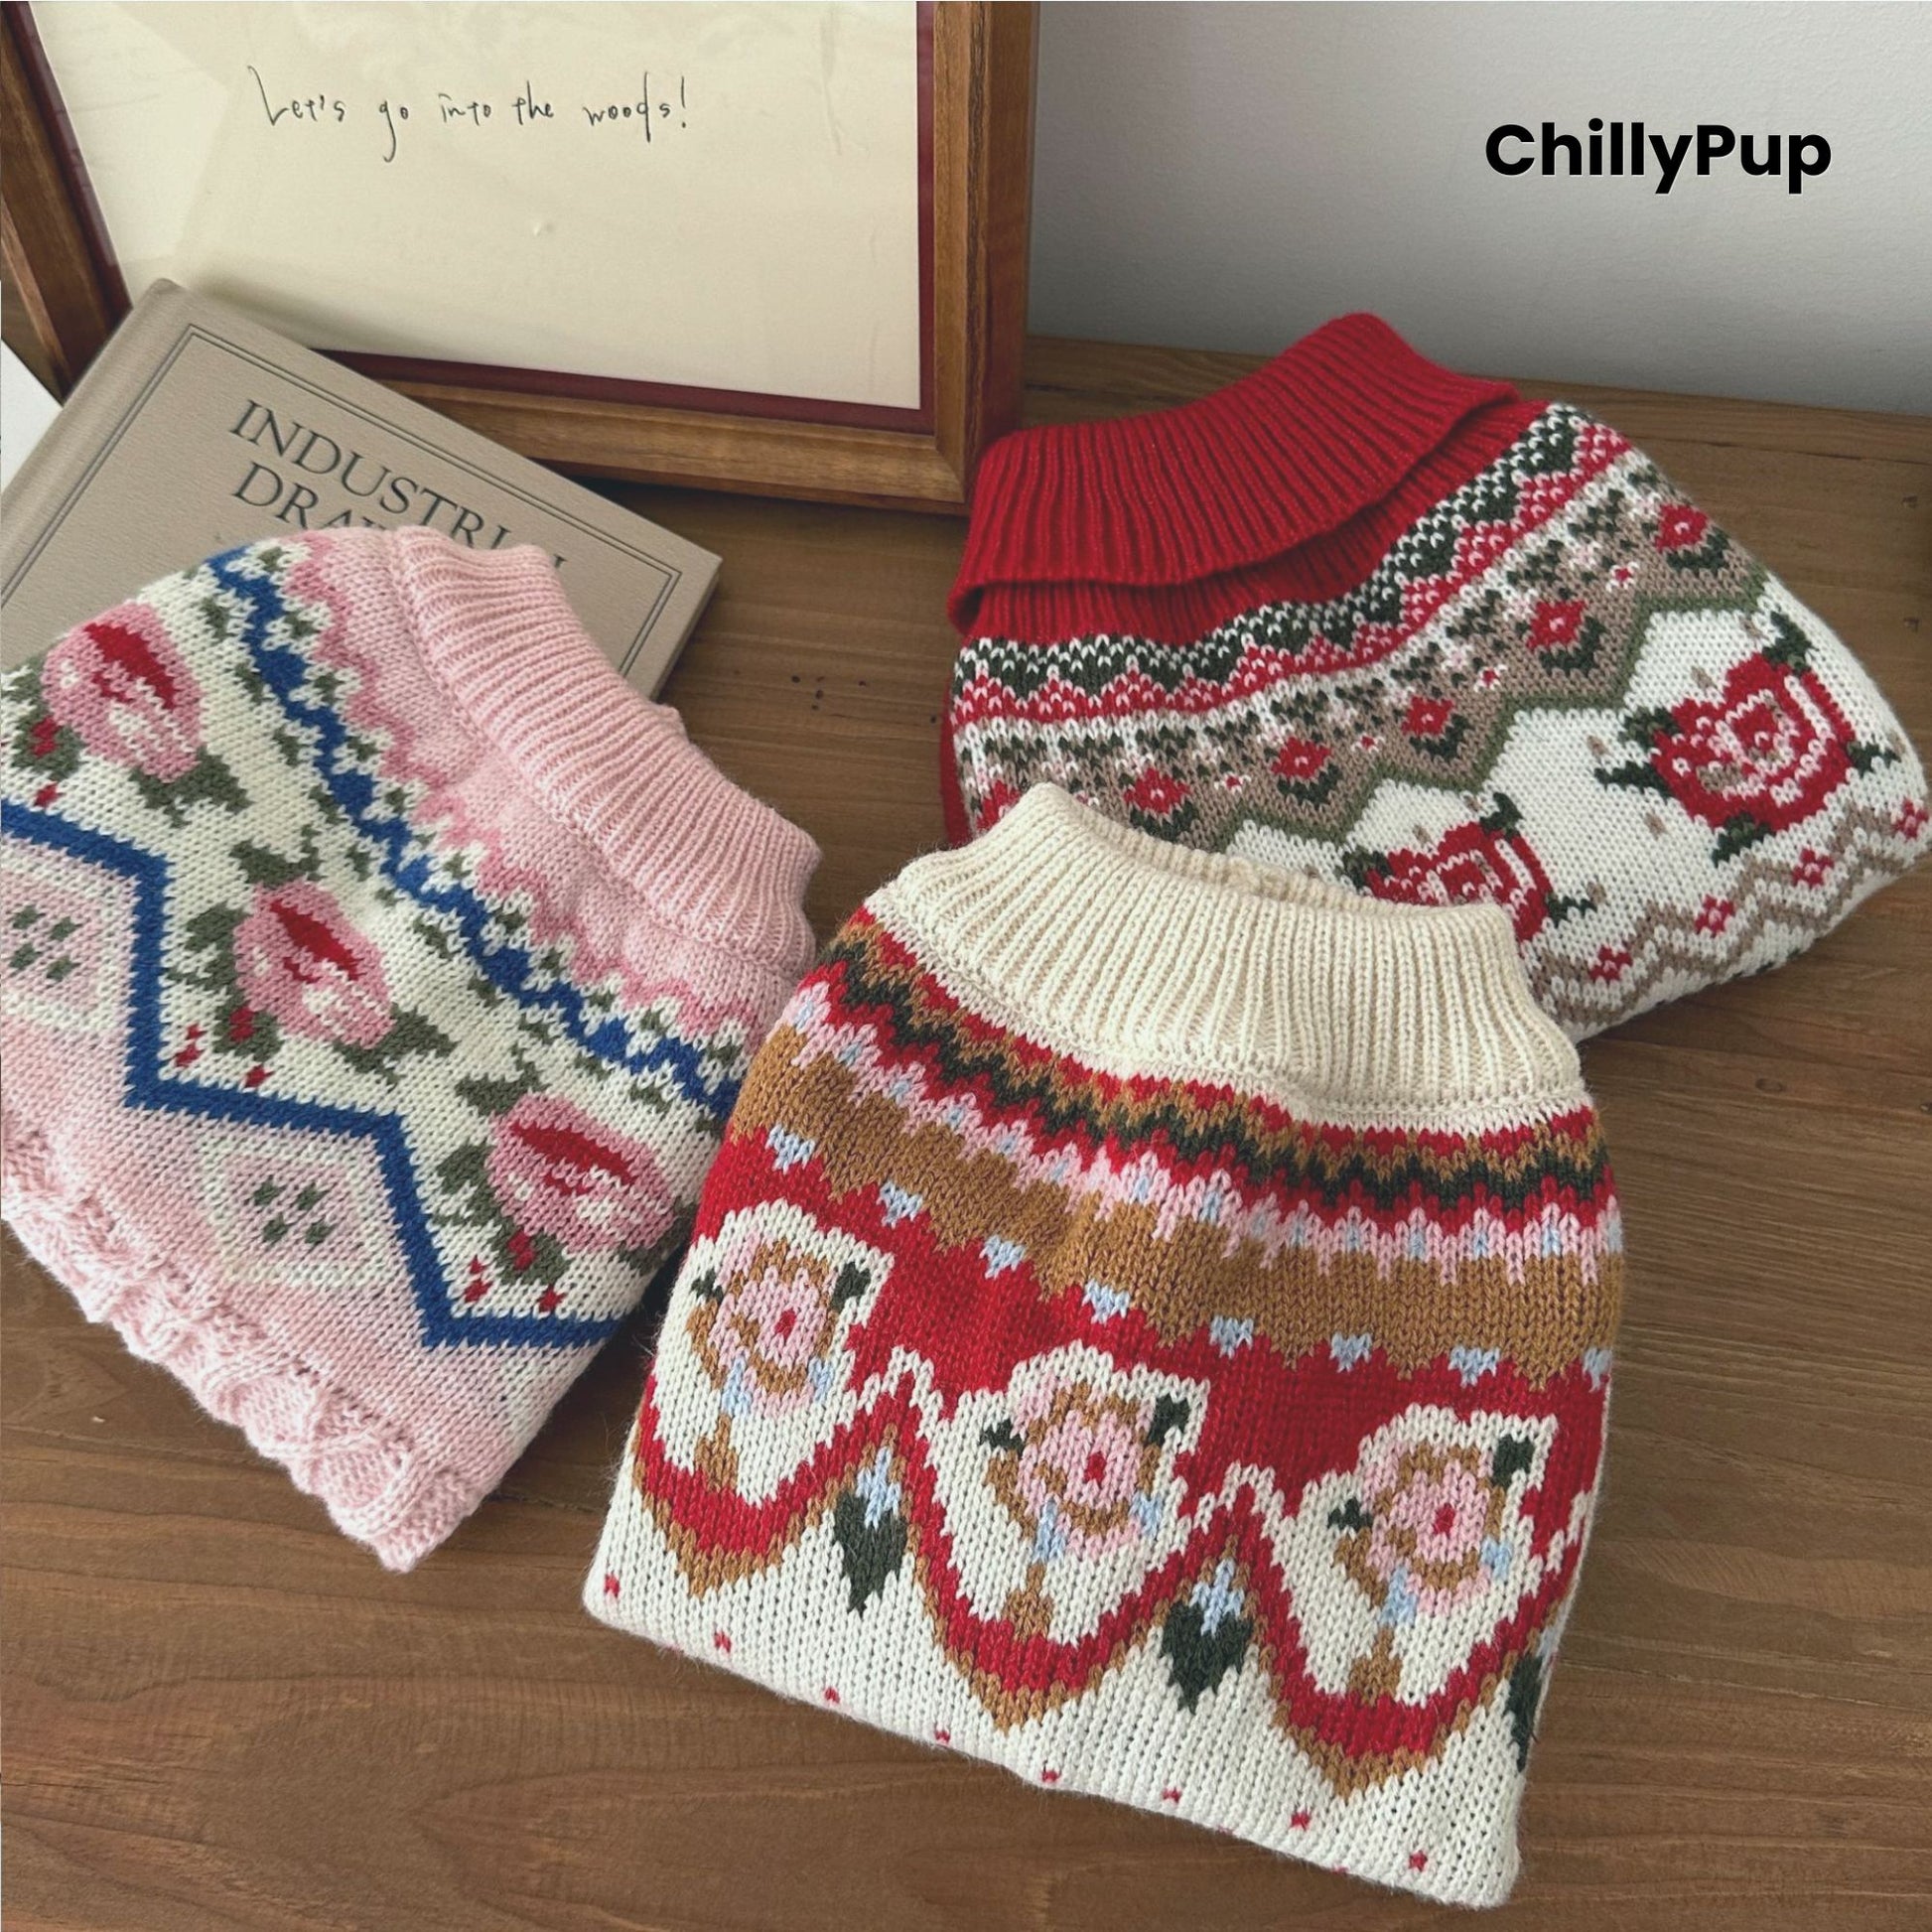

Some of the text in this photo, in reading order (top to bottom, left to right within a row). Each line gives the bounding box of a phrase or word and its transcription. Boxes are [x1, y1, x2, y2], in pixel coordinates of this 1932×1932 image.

[248, 66, 687, 163] Let's go into the woods!
[229, 399, 568, 569] INDUSTRI
[231, 461, 387, 531] DRA
